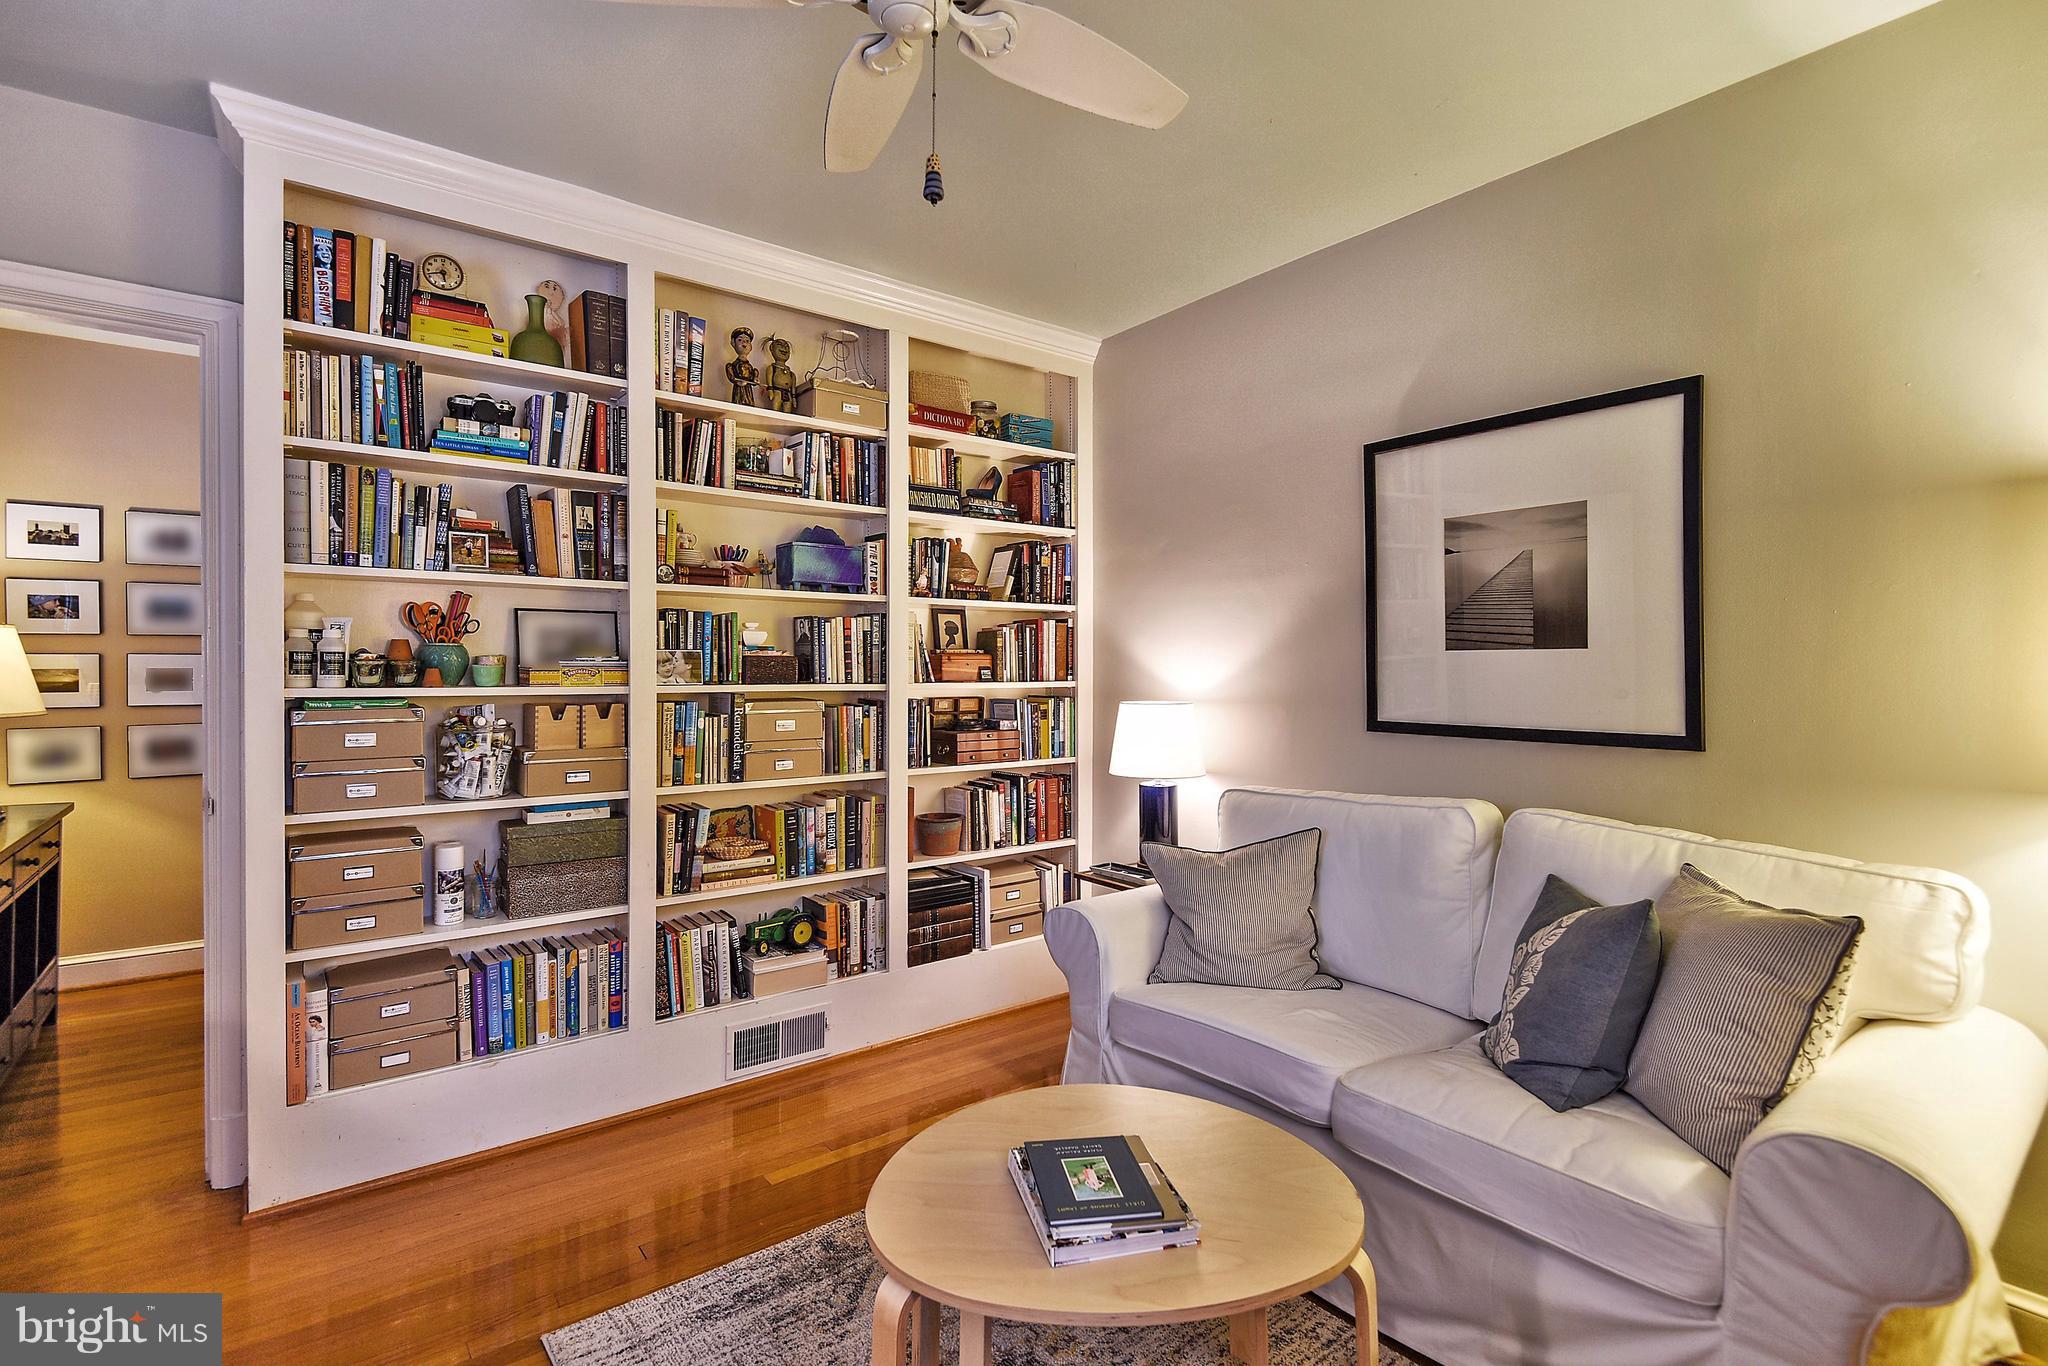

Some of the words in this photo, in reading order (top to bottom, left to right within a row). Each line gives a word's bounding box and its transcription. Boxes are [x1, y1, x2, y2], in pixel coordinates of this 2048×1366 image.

[285, 241, 294, 264] ANTHONY
[301, 250, 309, 281] FATHER
[317, 270, 332, 318] BLASPHEMY
[690, 360, 702, 385] FRANZEN
[923, 411, 966, 427] DICTIONARY
[909, 491, 937, 508] RNISHED
[936, 494, 960, 511] ROOMS
[872, 616, 880, 645] BEACH
[733, 707, 744, 771] Remodelista
[827, 813, 836, 849] THEROUX
[666, 837, 674, 859] BURN
[730, 926, 741, 948] EARTH
[503, 993, 512, 1011] PIVOT
[295, 1012, 301, 1020] AN
